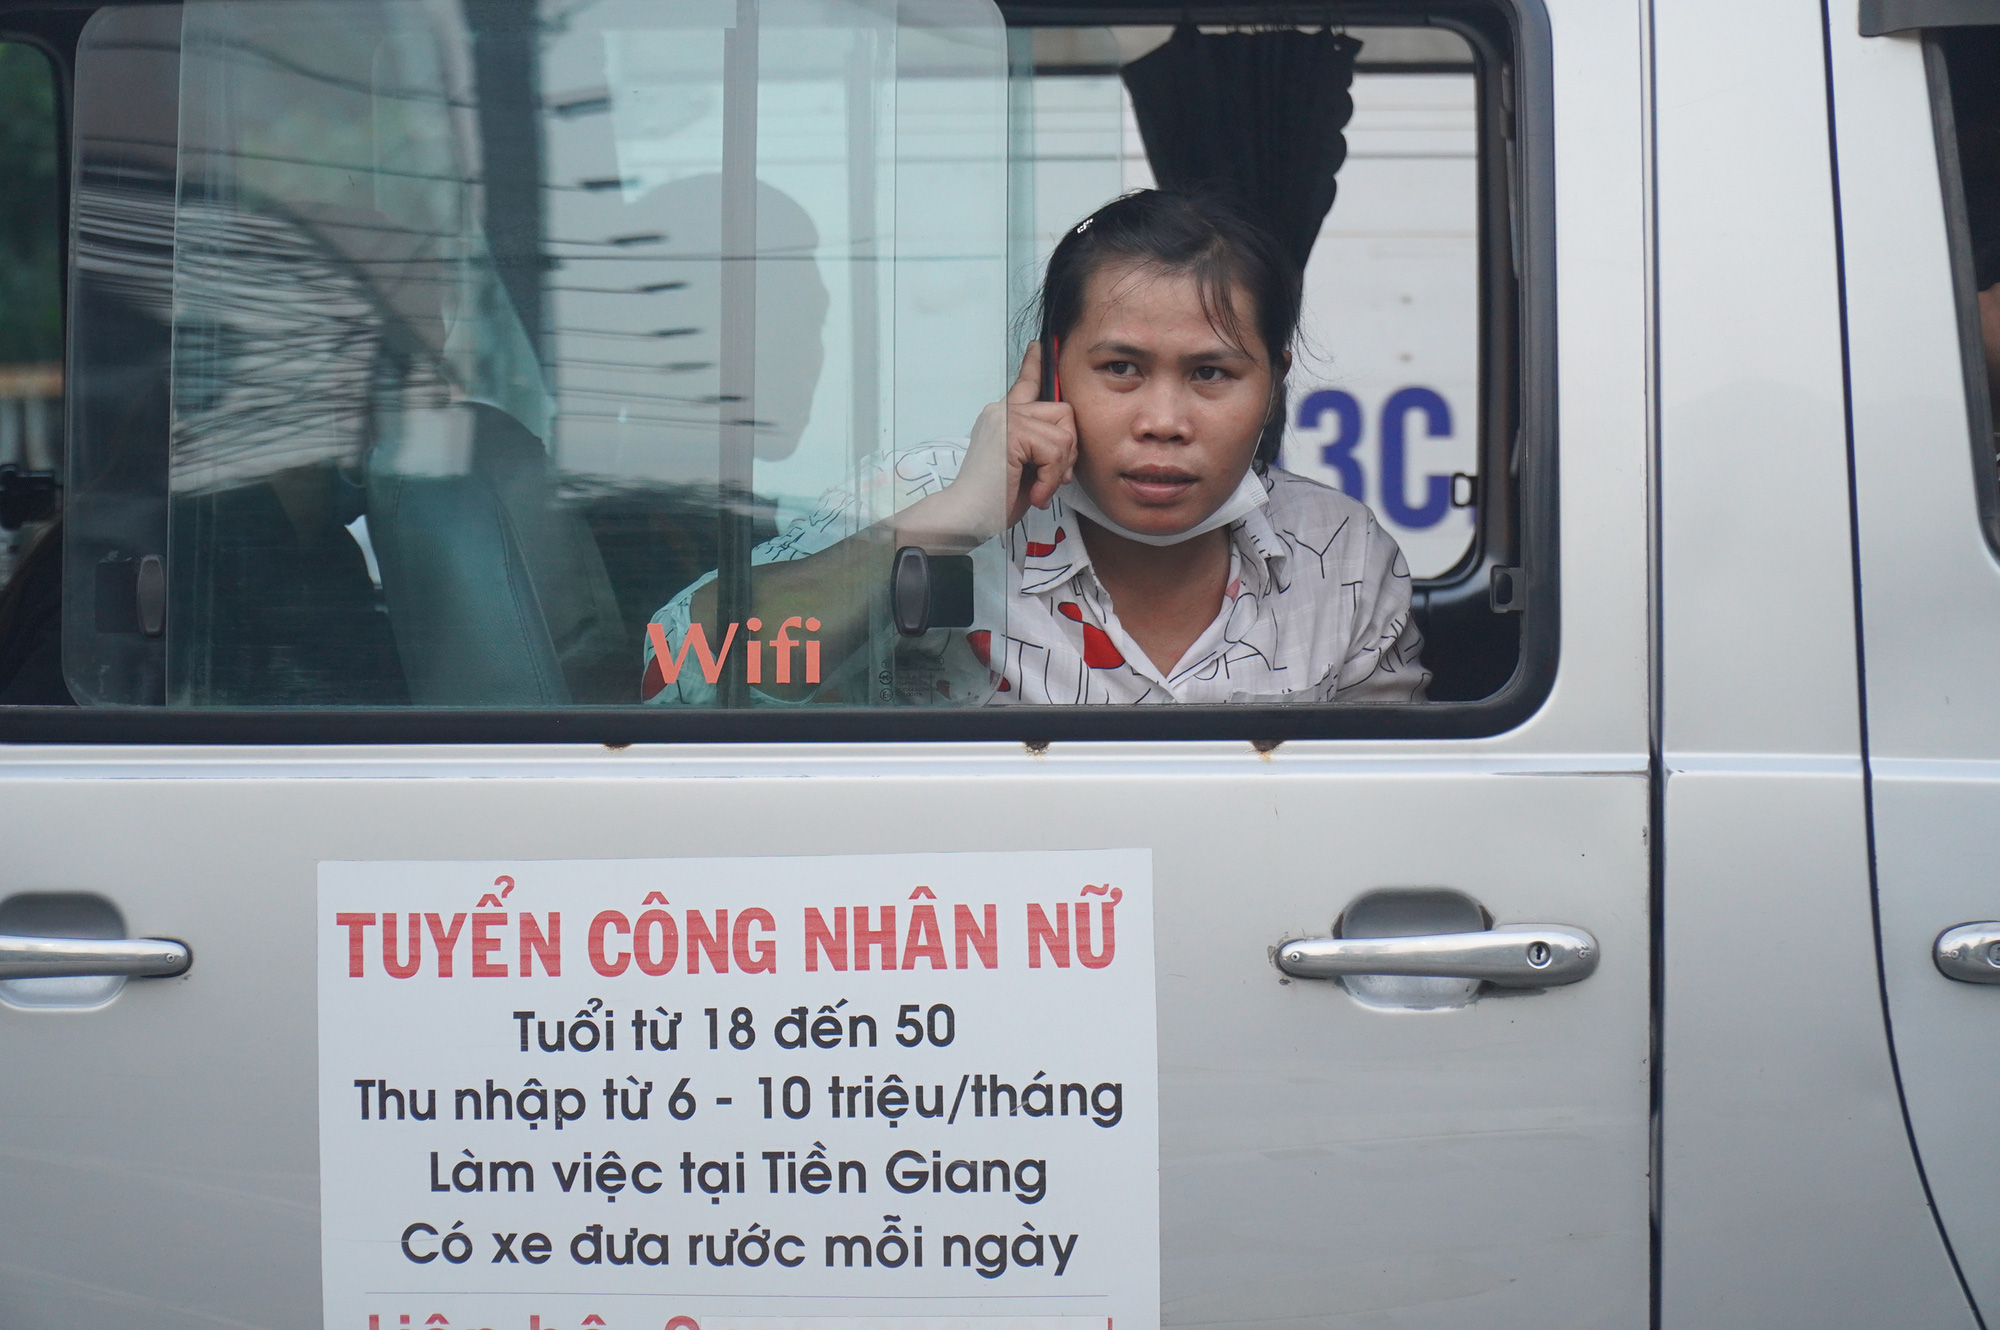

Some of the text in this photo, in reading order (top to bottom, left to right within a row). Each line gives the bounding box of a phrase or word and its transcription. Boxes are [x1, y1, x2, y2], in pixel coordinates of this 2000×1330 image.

[1275, 387, 1477, 528] 3C
[647, 616, 821, 684] Wifi
[336, 875, 1123, 979] TUYỂN CÔNG NHÂN NỮ
[513, 998, 954, 1052] Tuổi từ 18 đến 50
[355, 1071, 1122, 1129] Thu nhập từ 6 - 10 triệu/tháng
[431, 1141, 1046, 1204] Làm việc tại Tiền Giang
[402, 1215, 1078, 1278] Có xe đưa rước mỗi ngày
